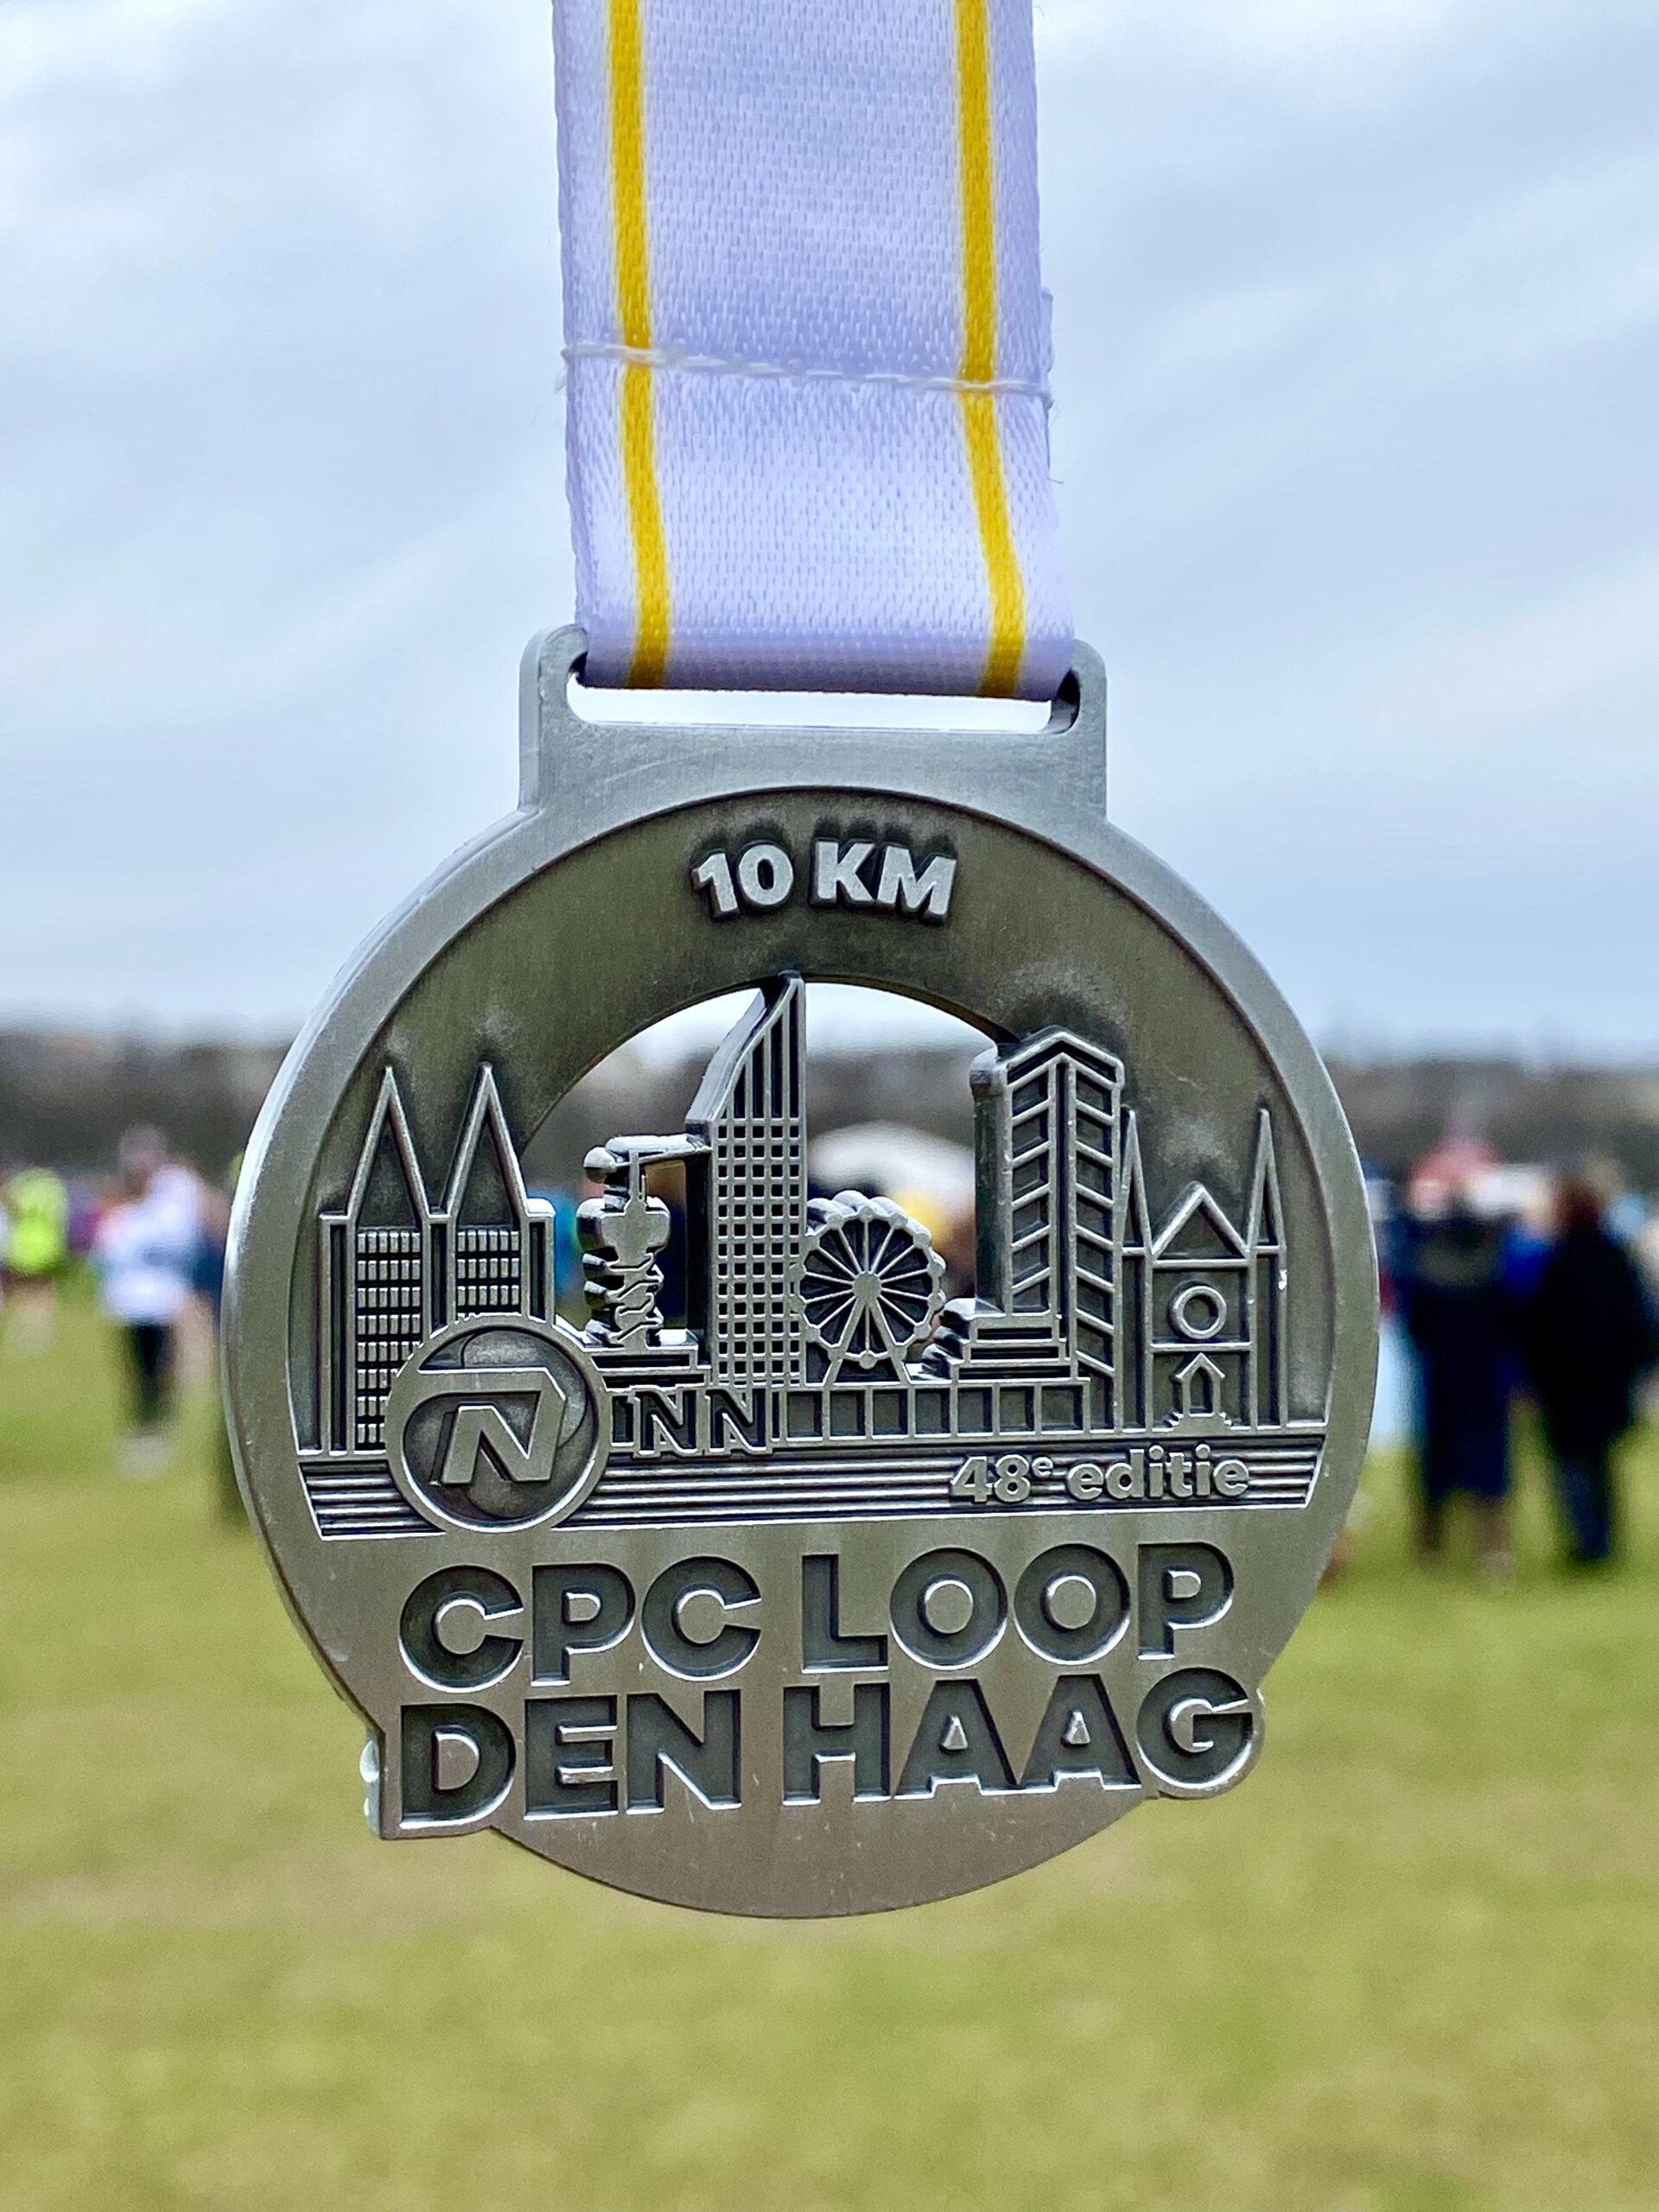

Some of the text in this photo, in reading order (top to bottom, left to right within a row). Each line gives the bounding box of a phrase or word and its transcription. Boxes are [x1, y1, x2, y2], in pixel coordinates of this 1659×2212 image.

[695, 839, 957, 919] 10 KM
[1065, 1443, 1249, 1501] editie
[399, 1541, 1235, 1692] CPC LOOP
[399, 1666, 1253, 1829] DEN HAAG
